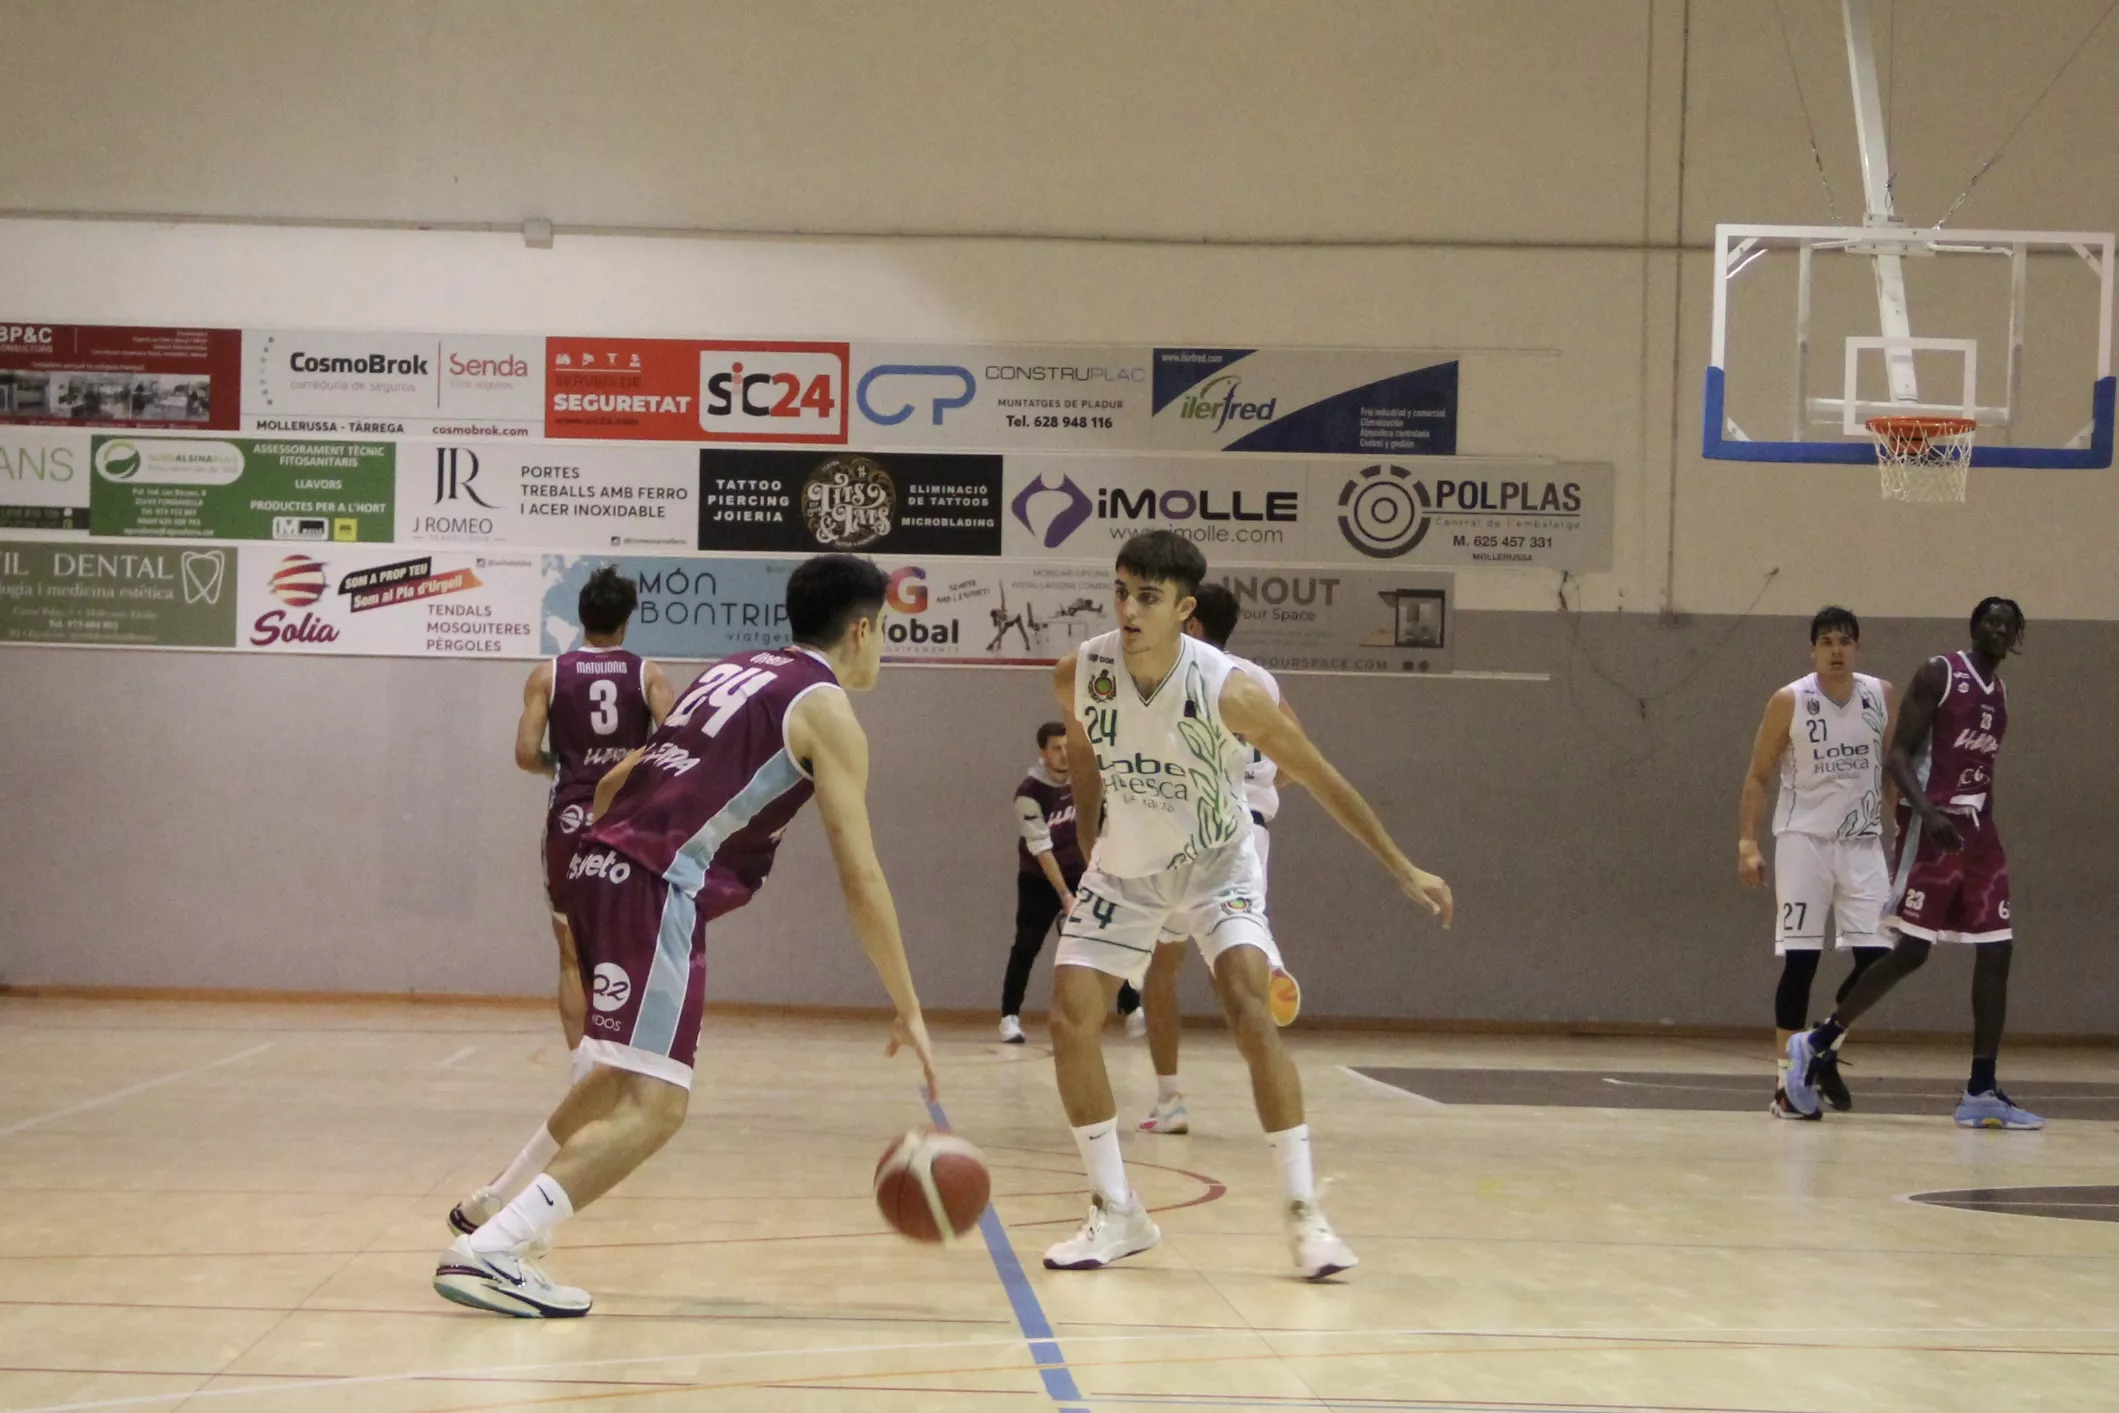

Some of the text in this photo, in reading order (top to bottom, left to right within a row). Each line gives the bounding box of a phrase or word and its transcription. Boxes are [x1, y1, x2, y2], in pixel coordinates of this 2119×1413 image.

[290, 352, 428, 375] CosmoBrok
[449, 353, 528, 377] Senda
[985, 365, 1145, 383] CONSTRUPLAC
[352, 380, 366, 391] de
[369, 382, 416, 393] seguros
[554, 394, 691, 413] SEGURETAT
[998, 399, 1124, 410] MUNTATGES DE PLADUR
[1180, 381, 1277, 433] ilerfred
[256, 420, 337, 432] MOLLERUSSA
[348, 419, 404, 433] TÀRREGA
[1006, 415, 1113, 430] Tel. 628 948 116
[432, 424, 529, 437] cosmobrok.com
[253, 444, 346, 457] ASSESSORAMENT
[279, 456, 359, 468] FITOSANITARIS
[521, 466, 580, 479] PORTES
[295, 479, 342, 490] LLAVORS
[521, 484, 688, 500] TREBALLS AMB FERRO
[716, 479, 782, 491] TATTOO
[707, 495, 790, 507] PIERCING
[908, 496, 989, 507] DE TATTOOS
[1436, 480, 1581, 511] POLPLAS
[250, 500, 386, 514] PRODUCTES PER A L'HORT
[529, 504, 569, 516] ACER
[574, 505, 666, 518] INOXIDABLE
[1098, 488, 1298, 522] iMOLLE
[713, 510, 783, 522] JOIERIA
[901, 517, 995, 528] MICROBLADING
[1435, 517, 1481, 527] Central
[1487, 518, 1501, 528] de
[412, 517, 493, 534] J ROMEO
[1108, 524, 1284, 544] wwimolle.com
[1453, 535, 1553, 548] M. 625 457 331
[53, 552, 174, 580] DENTAL
[344, 563, 429, 590] SOM A PROP TEU
[47, 582, 115, 598] medicina
[353, 593, 380, 609] Som
[427, 604, 492, 617] TENDALS
[1272, 608, 1316, 622] Space
[250, 610, 340, 646] Solia
[426, 622, 531, 636] MOSQUITERES
[887, 618, 959, 645] obal
[426, 637, 502, 652] PÈRGOLES
[725, 630, 791, 644] viatges
[576, 661, 628, 674] MATULIONIS
[589, 679, 619, 735] 3
[664, 663, 778, 738] 24
[1085, 706, 1117, 747] 24
[1806, 719, 1828, 743] 27
[1813, 743, 1869, 760] Lobe
[1905, 889, 1926, 911] 23
[1784, 902, 1807, 931] 27
